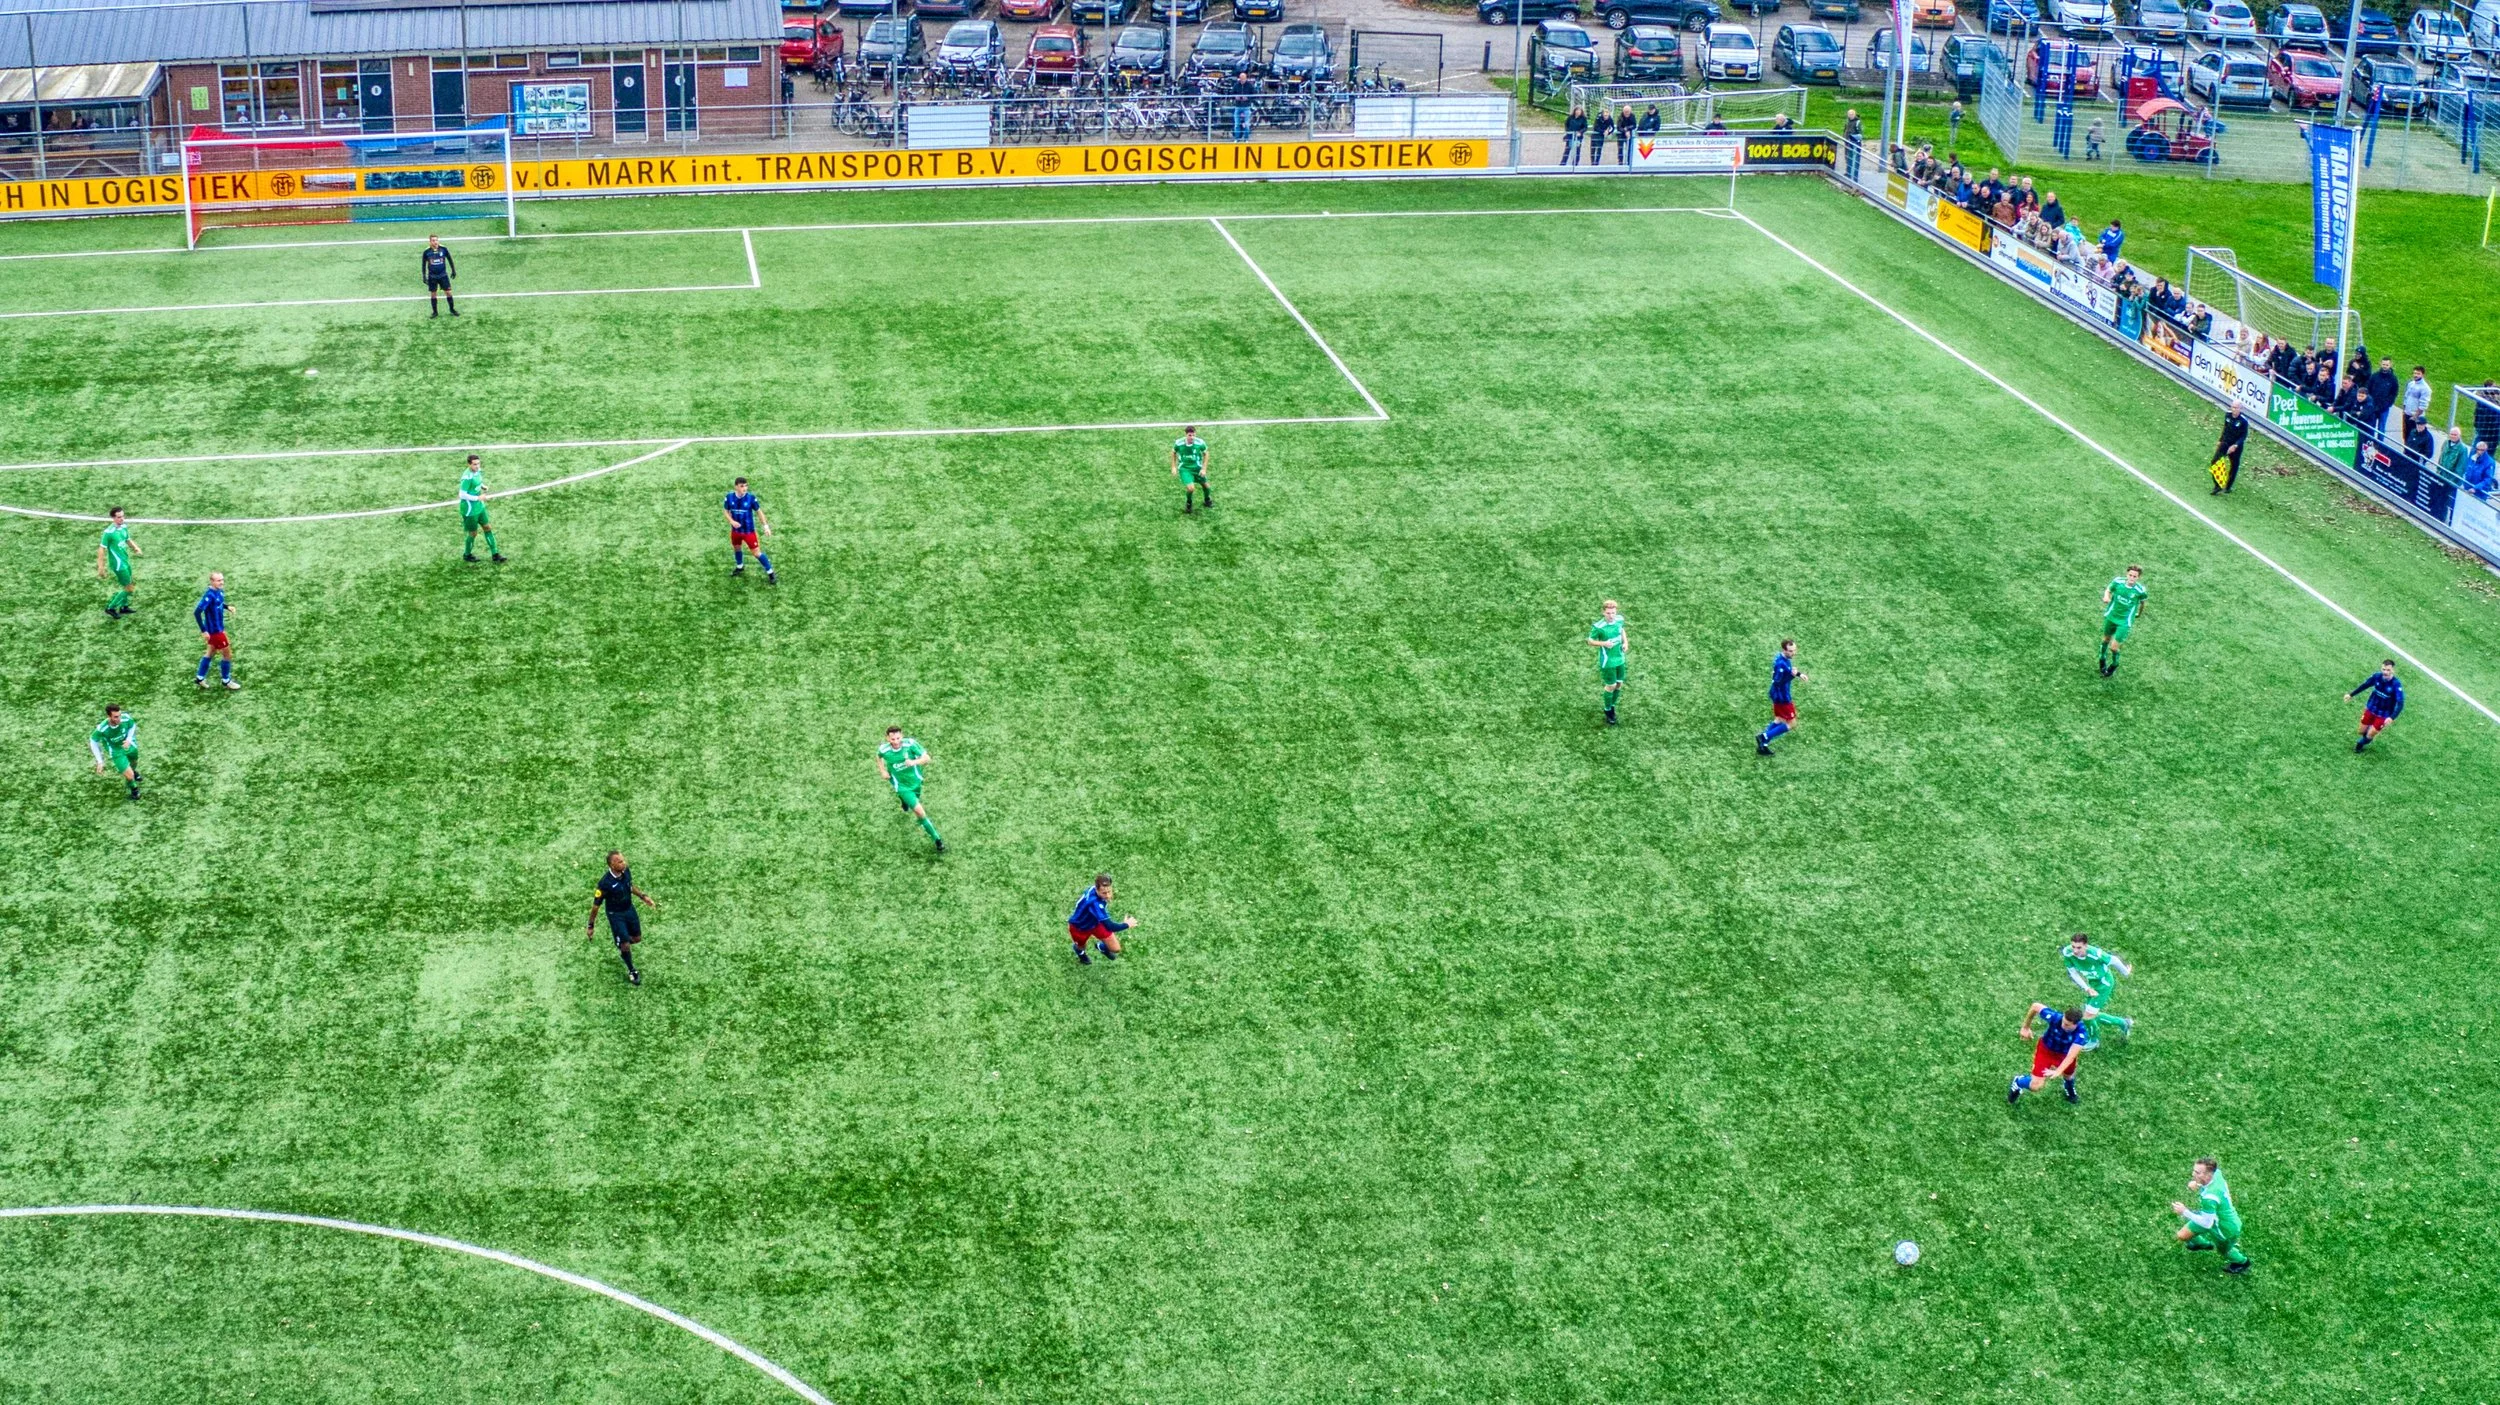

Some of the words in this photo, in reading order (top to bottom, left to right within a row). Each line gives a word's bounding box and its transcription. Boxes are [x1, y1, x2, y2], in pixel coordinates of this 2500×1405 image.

[1703, 138, 1738, 147] Opleidingen
[1747, 144, 1779, 158] 100%
[1782, 143, 1811, 158] BOB
[587, 159, 678, 186] MARK
[691, 159, 743, 183] int.
[756, 152, 943, 181] TRANSPORT
[957, 151, 1016, 176] B.V.
[1084, 146, 1218, 172] LOGISCH
[1234, 146, 1263, 169] IN
[1277, 143, 1434, 169] LOGISTIEK
[40, 183, 70, 207] IN
[84, 175, 251, 205] LOGISTIEK
[2195, 354, 2212, 373] den
[2214, 362, 2244, 394] Hartog
[2246, 381, 2266, 404] Glas
[2272, 394, 2299, 412] Peet
